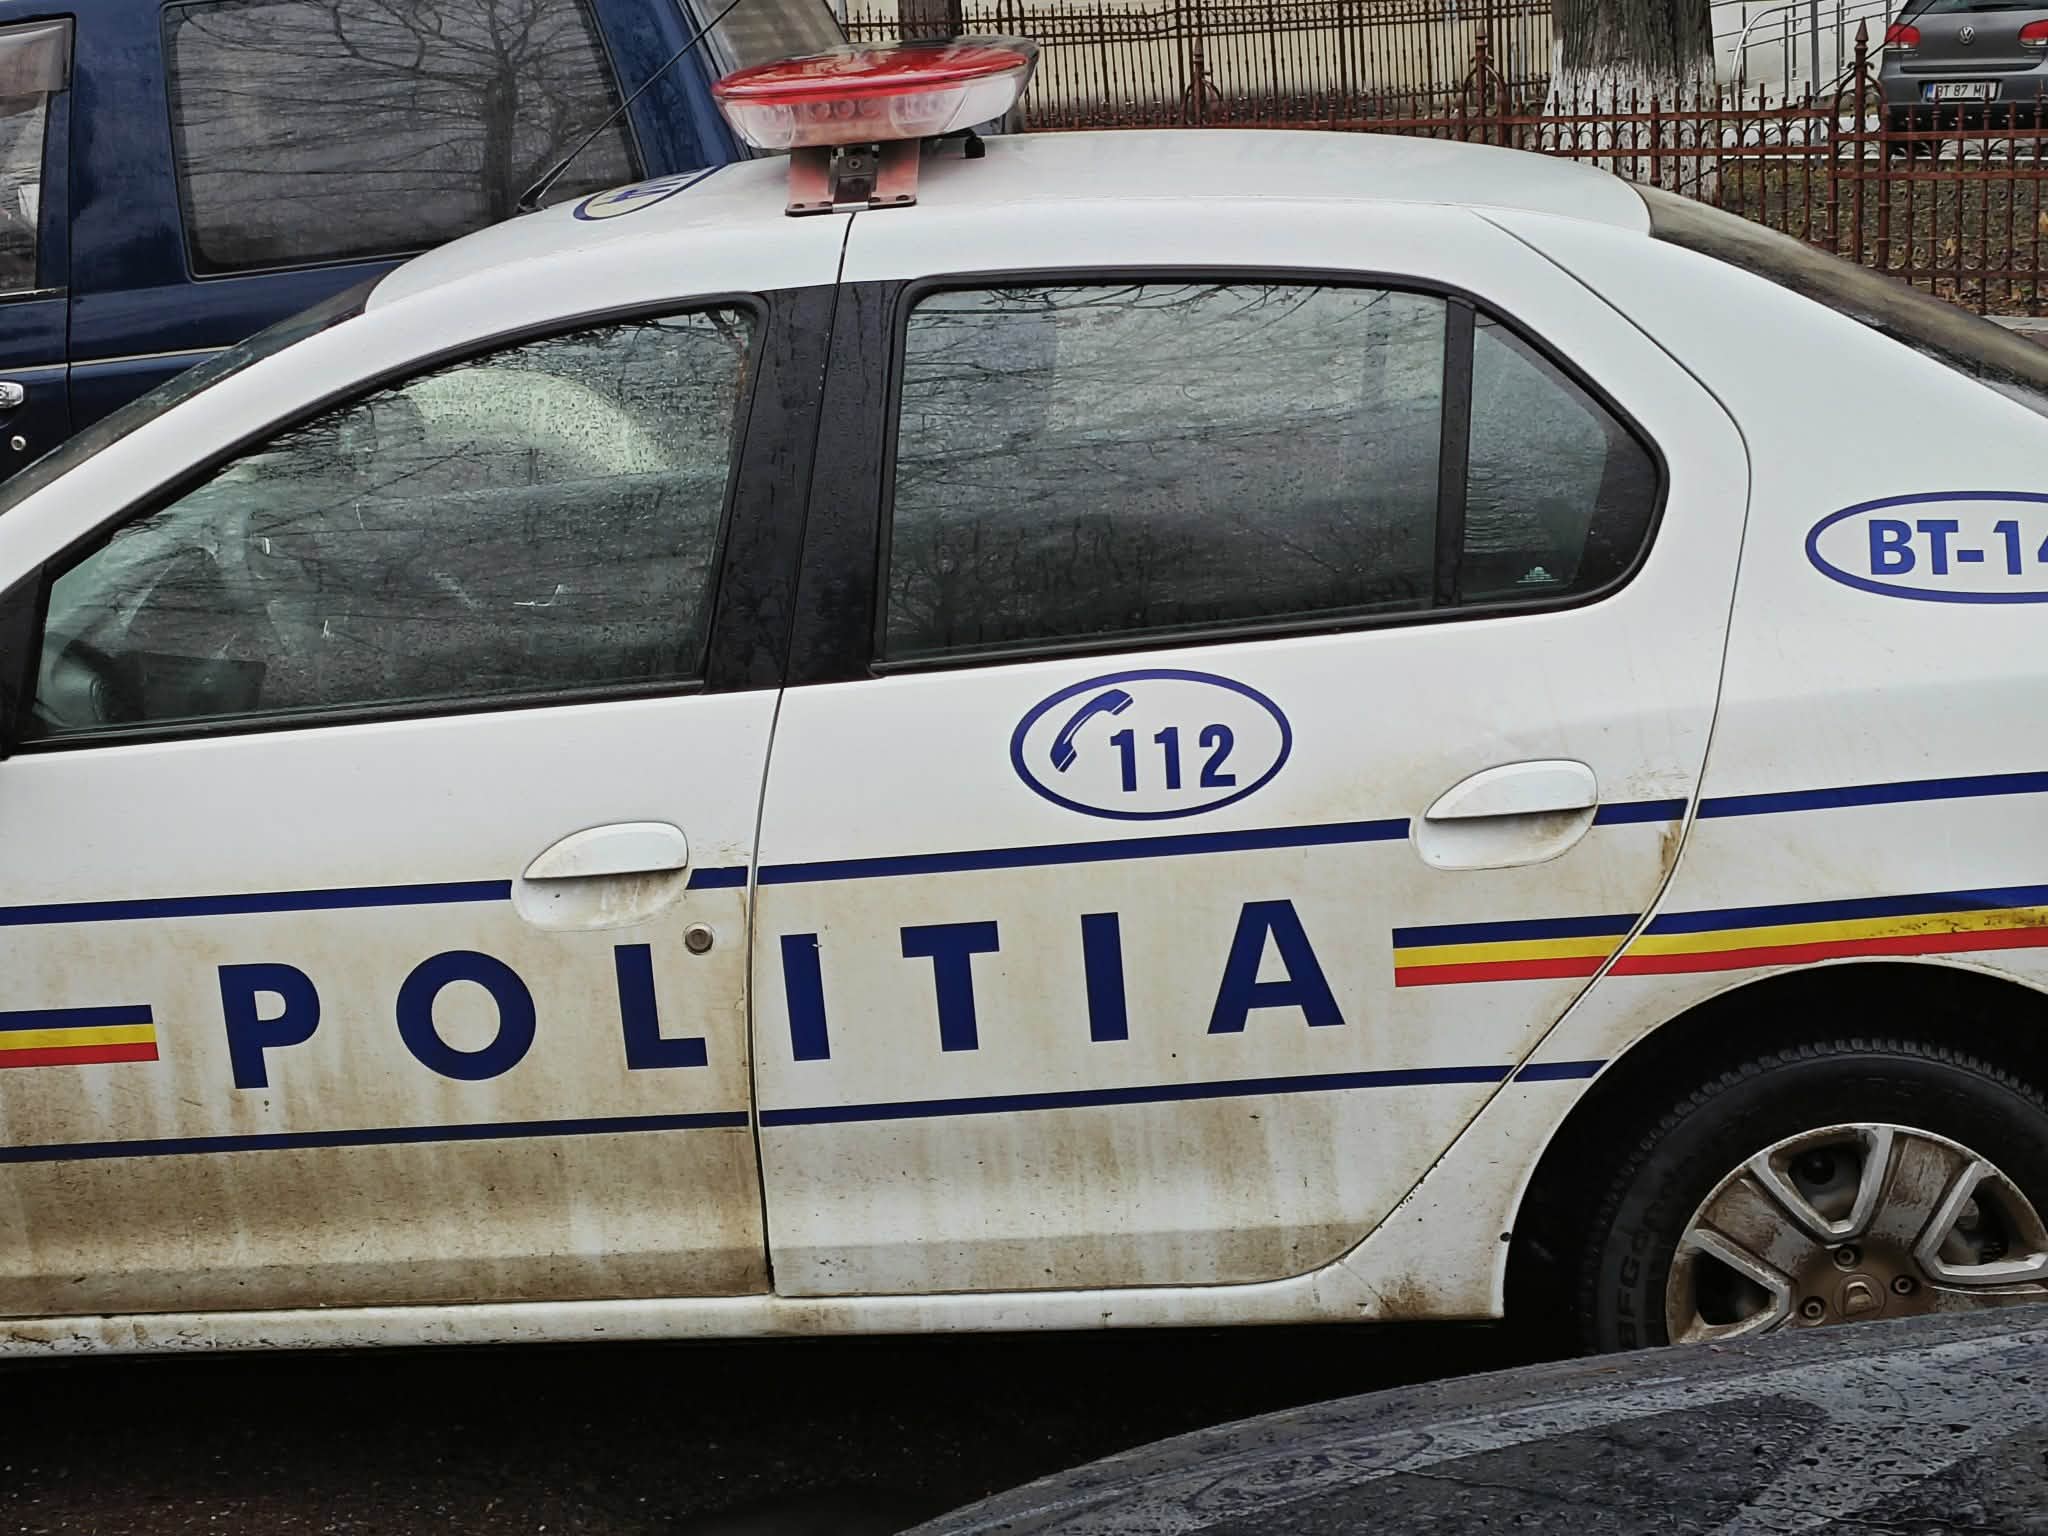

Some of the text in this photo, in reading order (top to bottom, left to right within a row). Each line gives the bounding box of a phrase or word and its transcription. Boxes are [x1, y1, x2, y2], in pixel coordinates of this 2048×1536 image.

[1953, 84, 1968, 97] 87
[1974, 84, 1988, 97] MI
[1869, 519, 2048, 575] BT-1
[1109, 723, 1236, 793] 112
[218, 900, 1346, 1088] POLITIA
